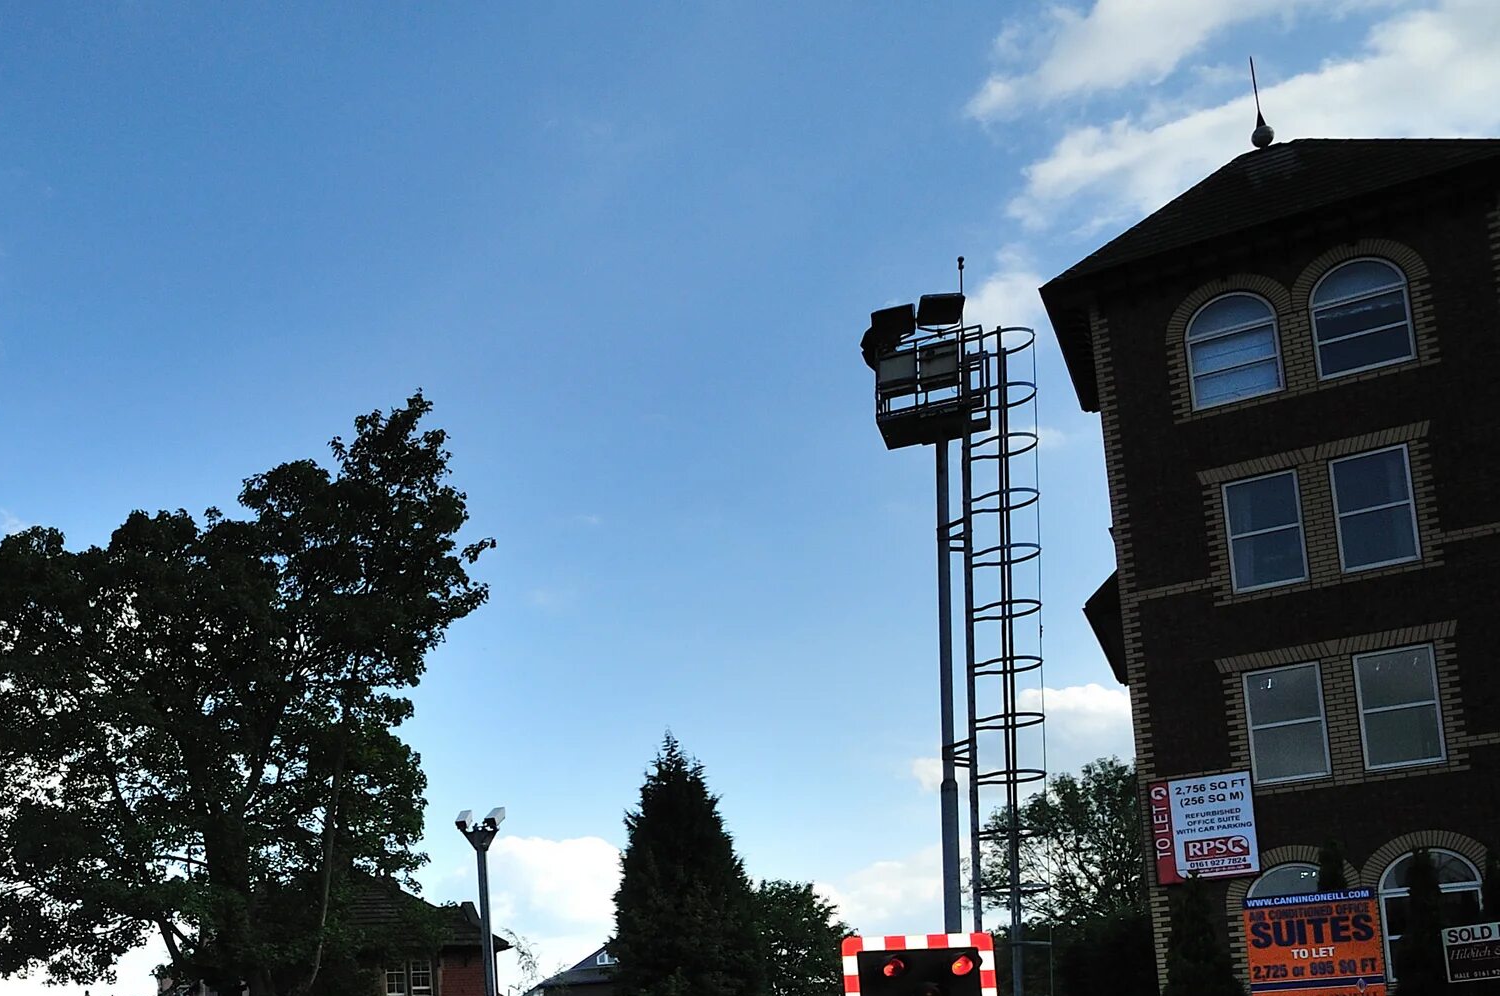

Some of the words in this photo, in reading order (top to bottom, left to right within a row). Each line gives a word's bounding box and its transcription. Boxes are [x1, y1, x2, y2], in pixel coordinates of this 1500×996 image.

[1175, 784, 1206, 796] 2,756
[1210, 781, 1228, 790] SQ
[1231, 778, 1246, 788] FT
[1180, 795, 1205, 808] (256
[1208, 793, 1226, 803] SQ
[1230, 791, 1244, 801] M)
[1152, 805, 1169, 834] LET
[1185, 808, 1241, 820] REFURBISHED
[1187, 818, 1215, 827] OFFICE
[1218, 816, 1240, 824] SUITE
[1176, 828, 1196, 836] WITH
[1217, 822, 1252, 831] PARKING
[1156, 838, 1172, 860] TO
[1188, 840, 1227, 856] RPS
[1227, 856, 1247, 865] 7824
[1247, 890, 1370, 908] WWW.CANNINGONEILL.COM
[1251, 913, 1374, 949] SUITES
[1448, 926, 1492, 944] SOLD
[1291, 949, 1308, 960] TO
[1312, 946, 1335, 958] LET
[1360, 958, 1377, 972] FT
